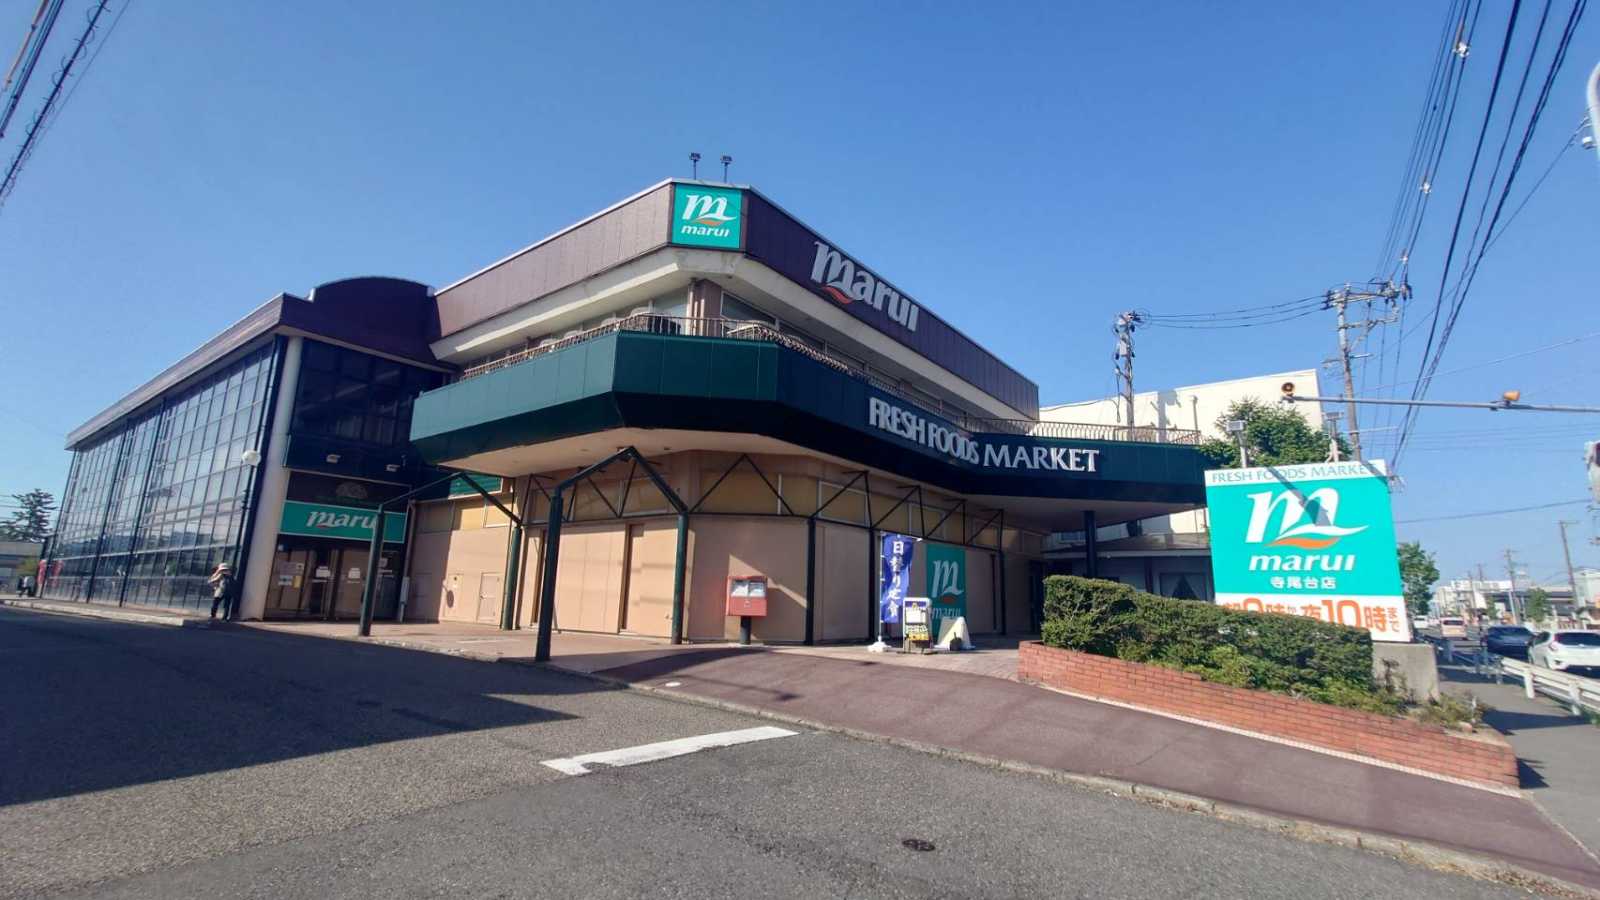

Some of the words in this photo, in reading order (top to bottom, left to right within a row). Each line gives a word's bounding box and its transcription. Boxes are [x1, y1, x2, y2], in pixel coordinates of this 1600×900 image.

[681, 225, 730, 237] marui
[810, 241, 920, 332] marui
[869, 396, 926, 451] FRESH
[927, 421, 979, 465] FOODS
[983, 444, 1100, 473] MARKET
[1212, 471, 1253, 483] FRESH
[1256, 467, 1307, 481] FOODS
[1248, 553, 1356, 571] marui
[1270, 575, 1337, 590] 寺尾台店
